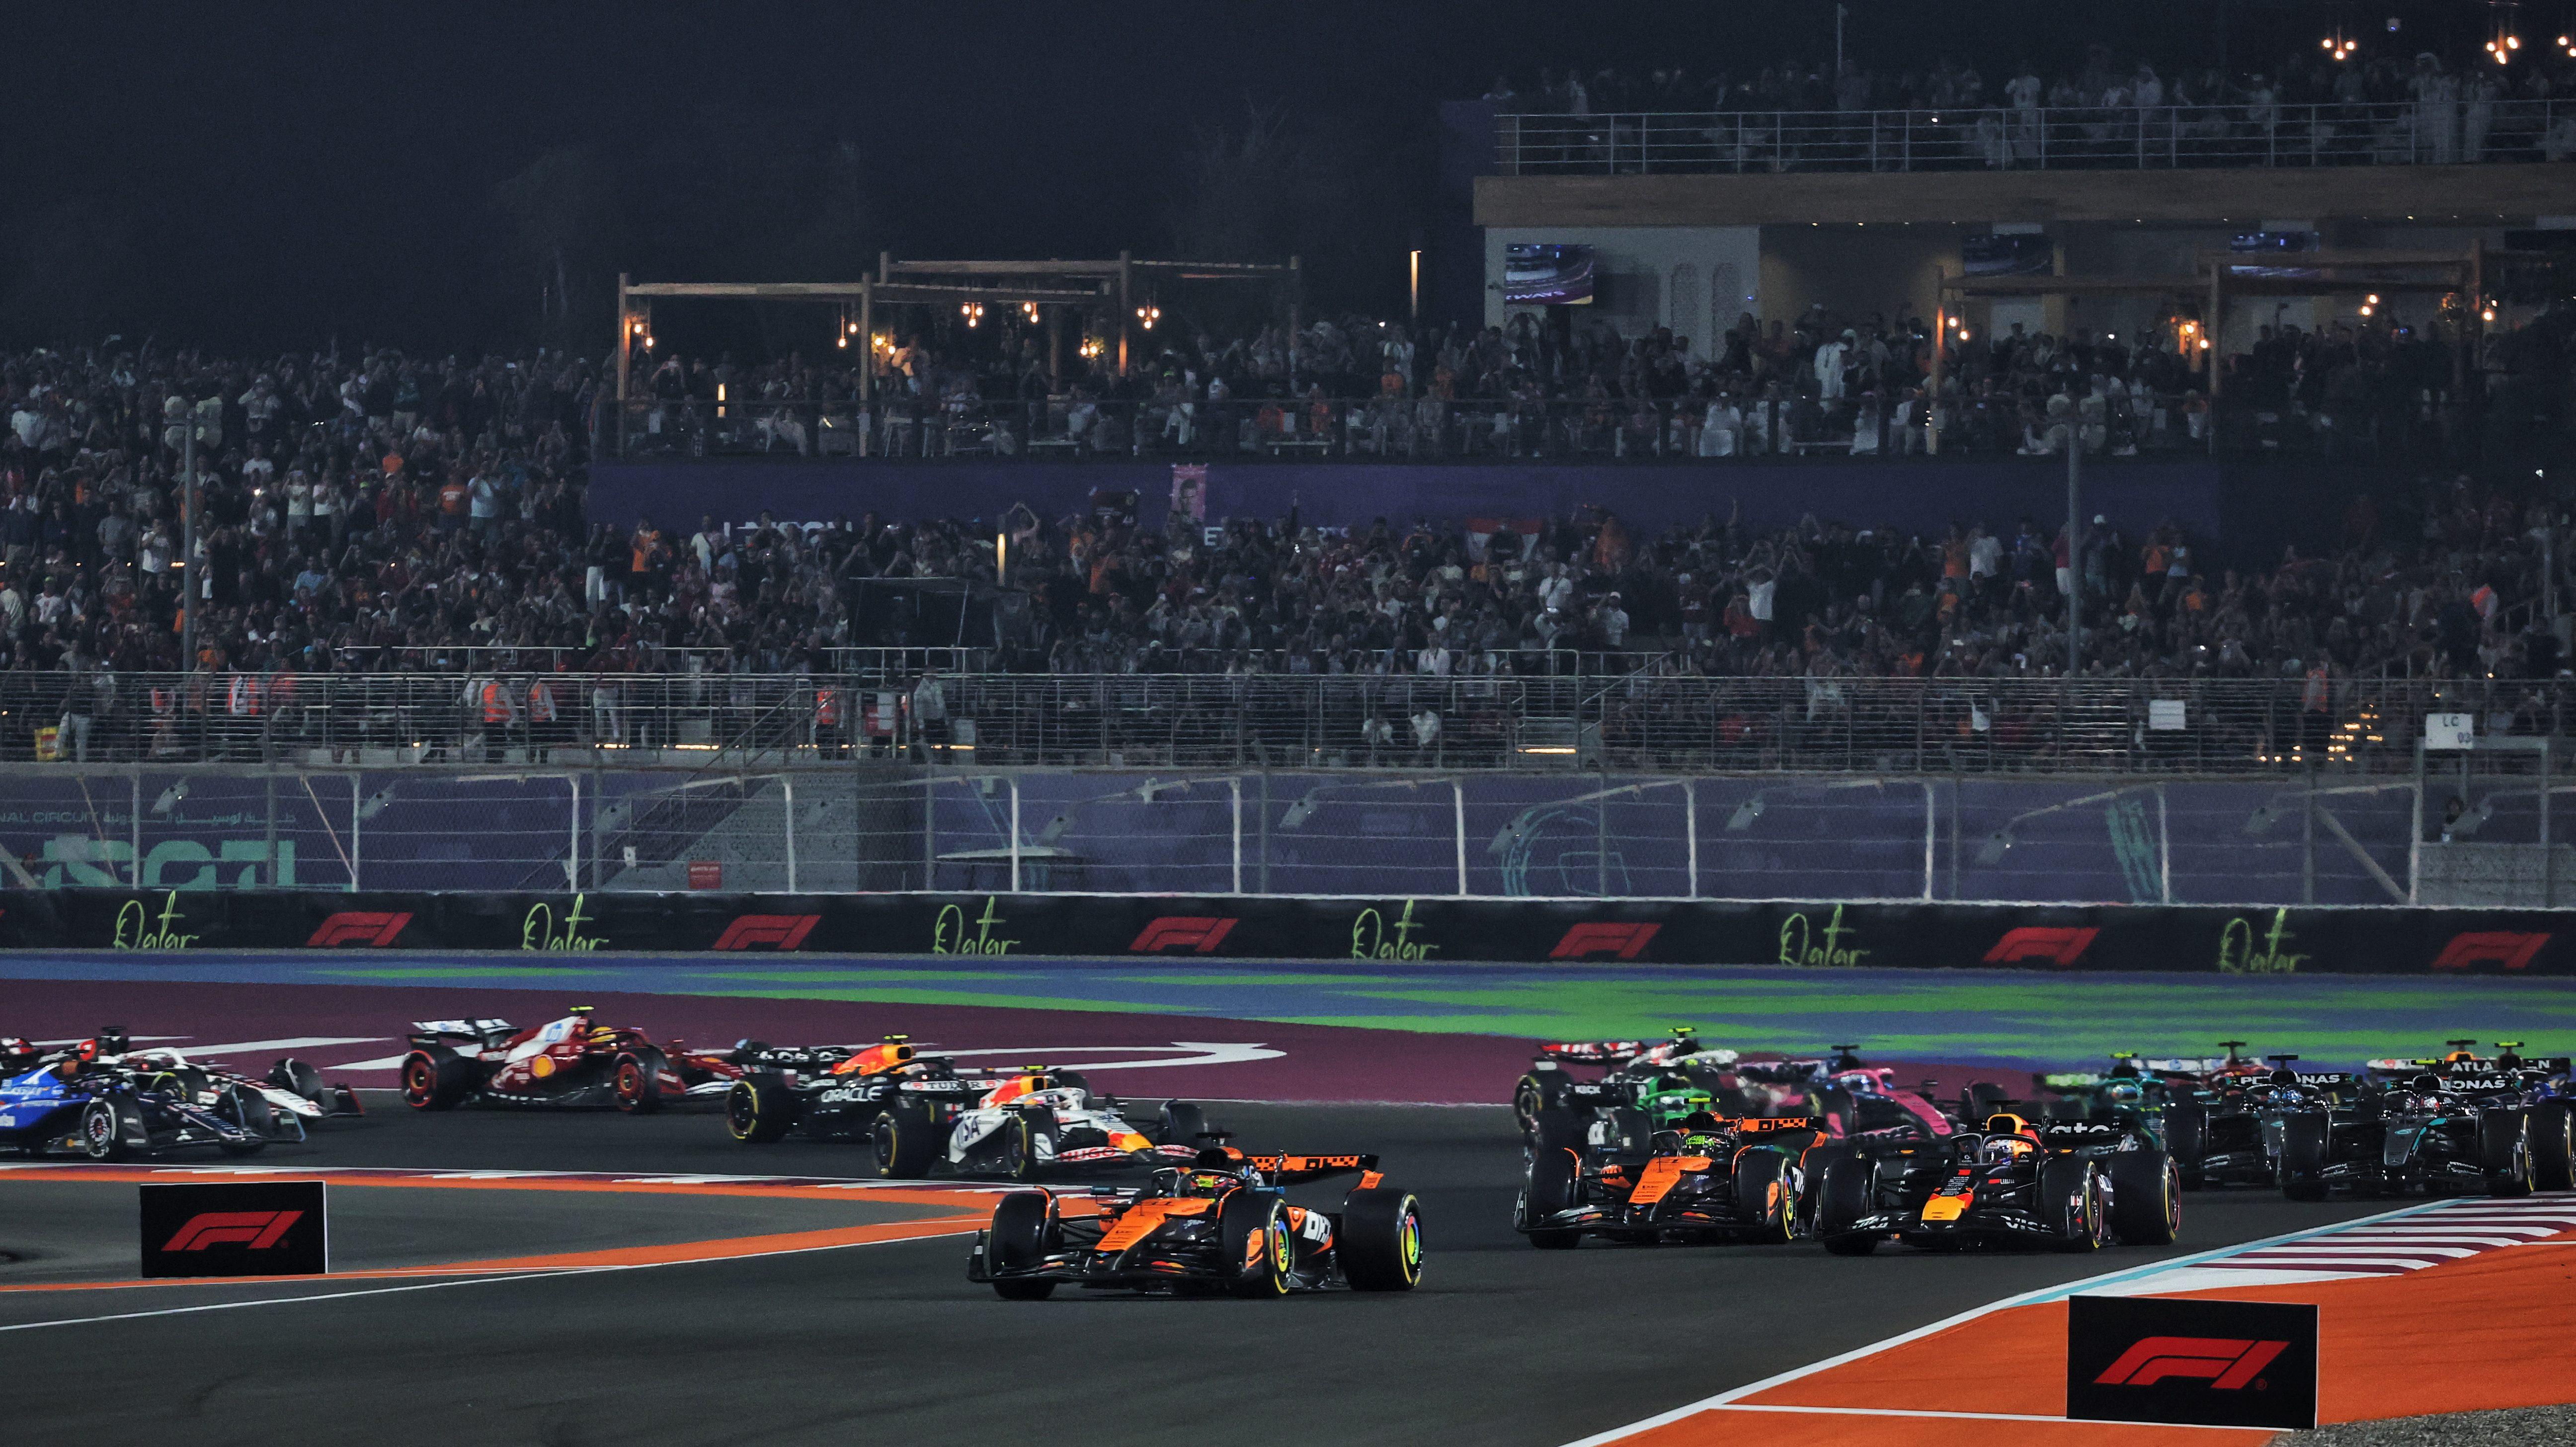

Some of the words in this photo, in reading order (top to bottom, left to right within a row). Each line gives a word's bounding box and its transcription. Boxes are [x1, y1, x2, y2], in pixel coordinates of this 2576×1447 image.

[115, 891, 199, 948] Qatar
[306, 912, 413, 947] F1
[522, 893, 609, 950] Qatar
[713, 915, 821, 951] F1
[933, 896, 1020, 955] Qatar
[1129, 917, 1239, 952] F1
[1352, 899, 1440, 960] Qatar
[1780, 904, 1870, 966] Qatar
[1549, 923, 1661, 959] F1
[1983, 927, 2100, 963] F1
[2218, 908, 2311, 974] Qatar
[2431, 932, 2552, 968] F1
[820, 1087, 883, 1103] ORACLE
[927, 1081, 980, 1091] TUDR
[1058, 1147, 1116, 1162] HUGO
[161, 1210, 304, 1251] F1
[2093, 1336, 2291, 1389] F1
